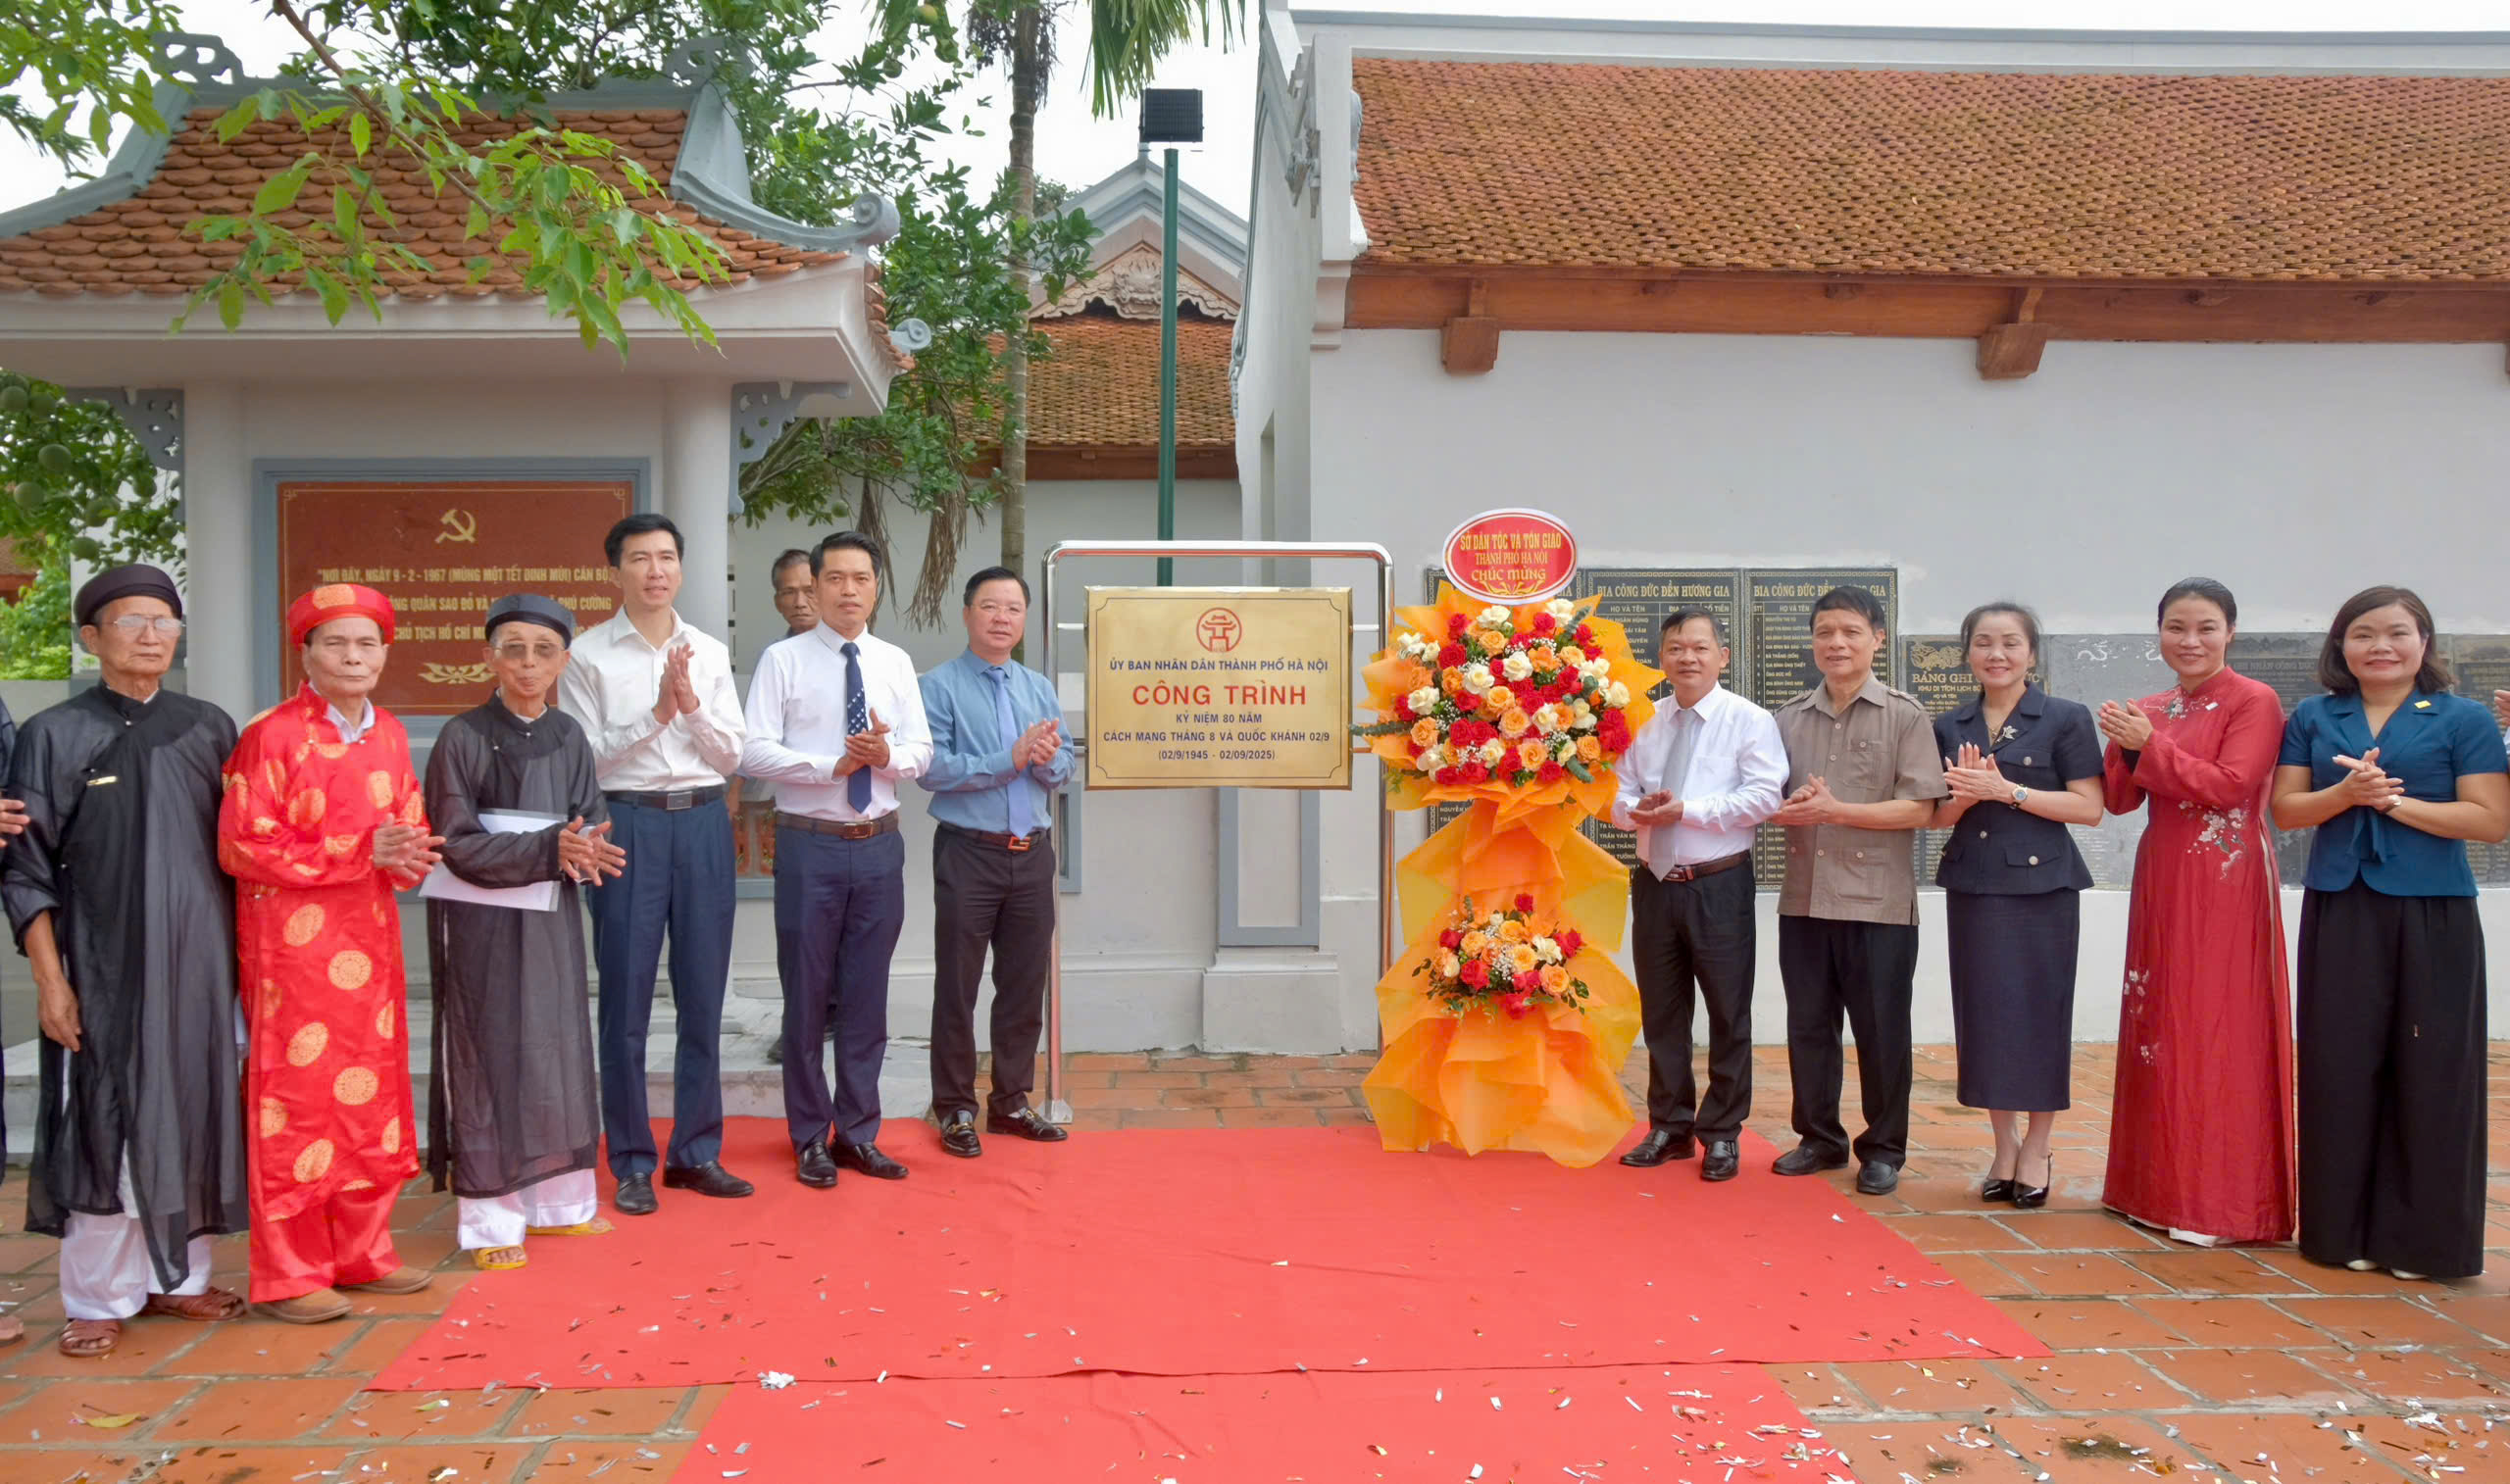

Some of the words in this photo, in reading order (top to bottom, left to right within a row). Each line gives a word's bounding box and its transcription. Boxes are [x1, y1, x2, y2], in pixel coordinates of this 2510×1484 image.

[1460, 530, 1471, 550] SỞ
[1473, 531, 1489, 550] DÂN
[1510, 529, 1522, 549] VÀ
[1523, 530, 1539, 549] TÔN
[1542, 530, 1562, 549] GIÁO
[1476, 550, 1502, 565] THÀNH
[1503, 550, 1520, 565] PHỐ
[1521, 551, 1532, 564] HÀ
[1533, 549, 1548, 565] NỘI
[365, 566, 391, 582] NGÀY
[393, 569, 401, 582] 9
[408, 569, 416, 582] 2
[424, 569, 446, 582] 1967
[506, 564, 523, 582] TẾT
[574, 565, 594, 581] CÁN
[1471, 566, 1504, 581] CHÚC
[1615, 582, 1638, 597] CÔNG
[1640, 582, 1659, 597] ĐỨC
[1661, 579, 1680, 597] ĐỀN
[1714, 585, 1730, 597] GIA
[1753, 584, 1769, 597] BIA
[1771, 582, 1795, 597] CÔNG
[1797, 582, 1815, 597] ĐỨC
[1870, 585, 1886, 597] GIA
[439, 597, 459, 611] SAO
[460, 591, 474, 611] ĐỎ
[476, 594, 489, 611] VÀ
[579, 594, 612, 611] CƯỜNG
[1798, 603, 1810, 613] TÊN
[415, 625, 436, 642] TỊCH
[454, 623, 472, 640] CHÍ
[1109, 658, 1127, 671] ỦY
[1128, 660, 1151, 670] BAN
[1154, 658, 1187, 670] NHÂN
[1190, 658, 1216, 670] DÂN
[1218, 658, 1257, 670] THÀNH
[1260, 657, 1284, 670] PHỐ
[1287, 658, 1304, 670] HÀ
[1307, 658, 1329, 673] NỘI
[1912, 670, 1946, 683] BẢNG
[1949, 673, 1973, 683] GHI
[1131, 679, 1212, 706] CÔNG
[1224, 679, 1307, 706] TRÌNH
[1176, 710, 1189, 723] KỶ
[1193, 712, 1219, 726] NIỆM
[1223, 714, 1235, 723] 80
[1238, 712, 1263, 723] NĂM
[1103, 728, 1131, 742] CÁCH
[1135, 731, 1167, 744] MẠNG
[1170, 728, 1207, 742] THÁNG
[1209, 731, 1216, 742] 8
[1219, 728, 1233, 742] VÀ
[1237, 727, 1267, 742] QUỐC
[1270, 728, 1306, 742] KHÁNH
[1309, 731, 1330, 743] 02/9
[1158, 749, 1209, 761] (02/9/1945
[1219, 749, 1276, 761] 02/09/2025)
